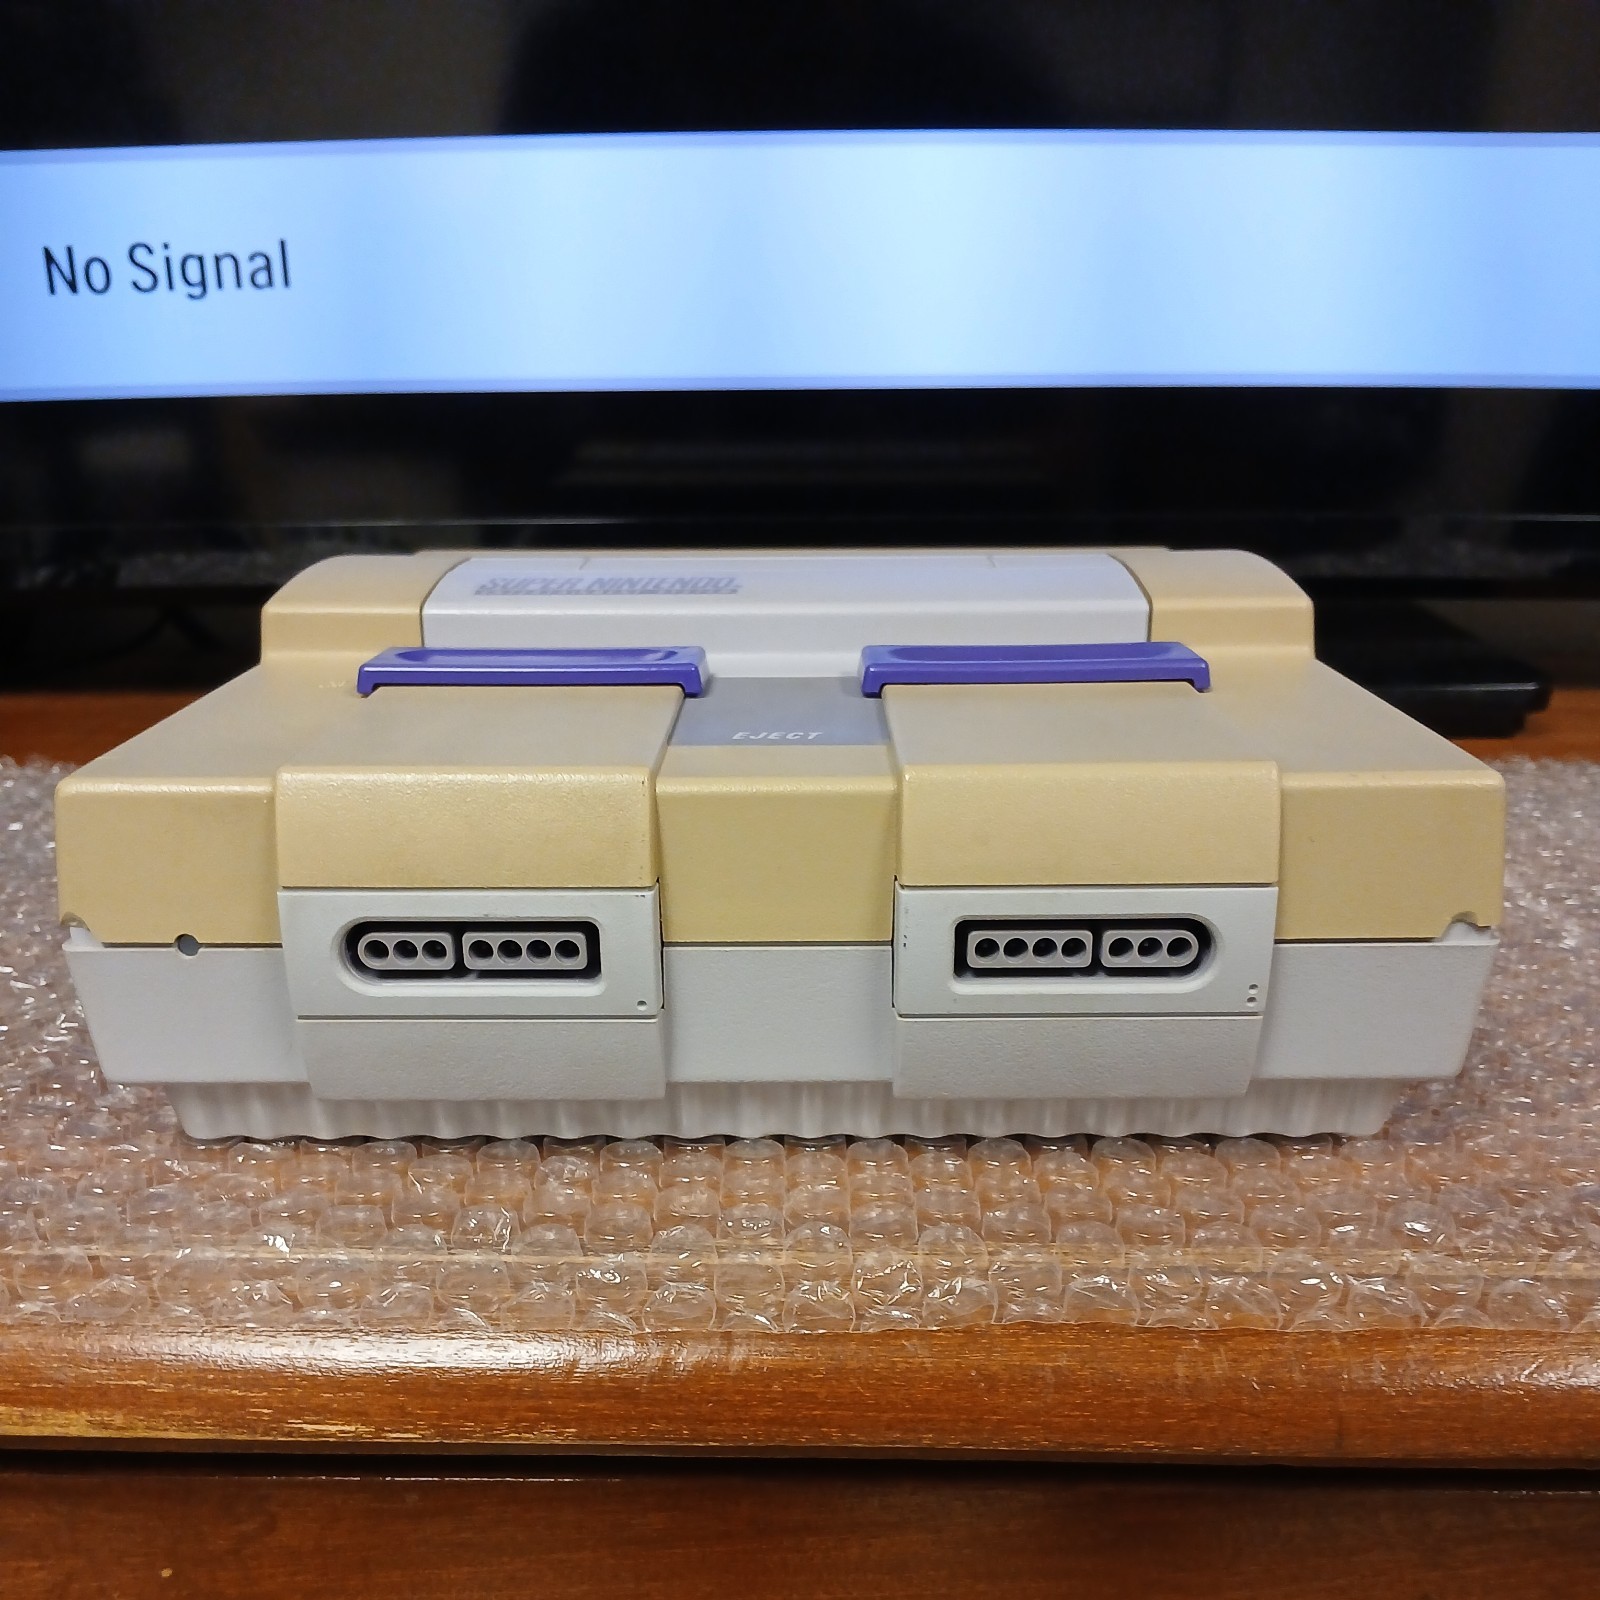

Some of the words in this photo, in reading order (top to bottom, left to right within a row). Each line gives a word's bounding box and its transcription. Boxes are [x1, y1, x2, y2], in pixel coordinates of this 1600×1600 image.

[42, 244, 111, 296] No
[127, 238, 292, 301] Signal
[478, 577, 585, 591] SUPER
[587, 577, 738, 590] NINTENDO
[731, 731, 823, 740] EJECT
